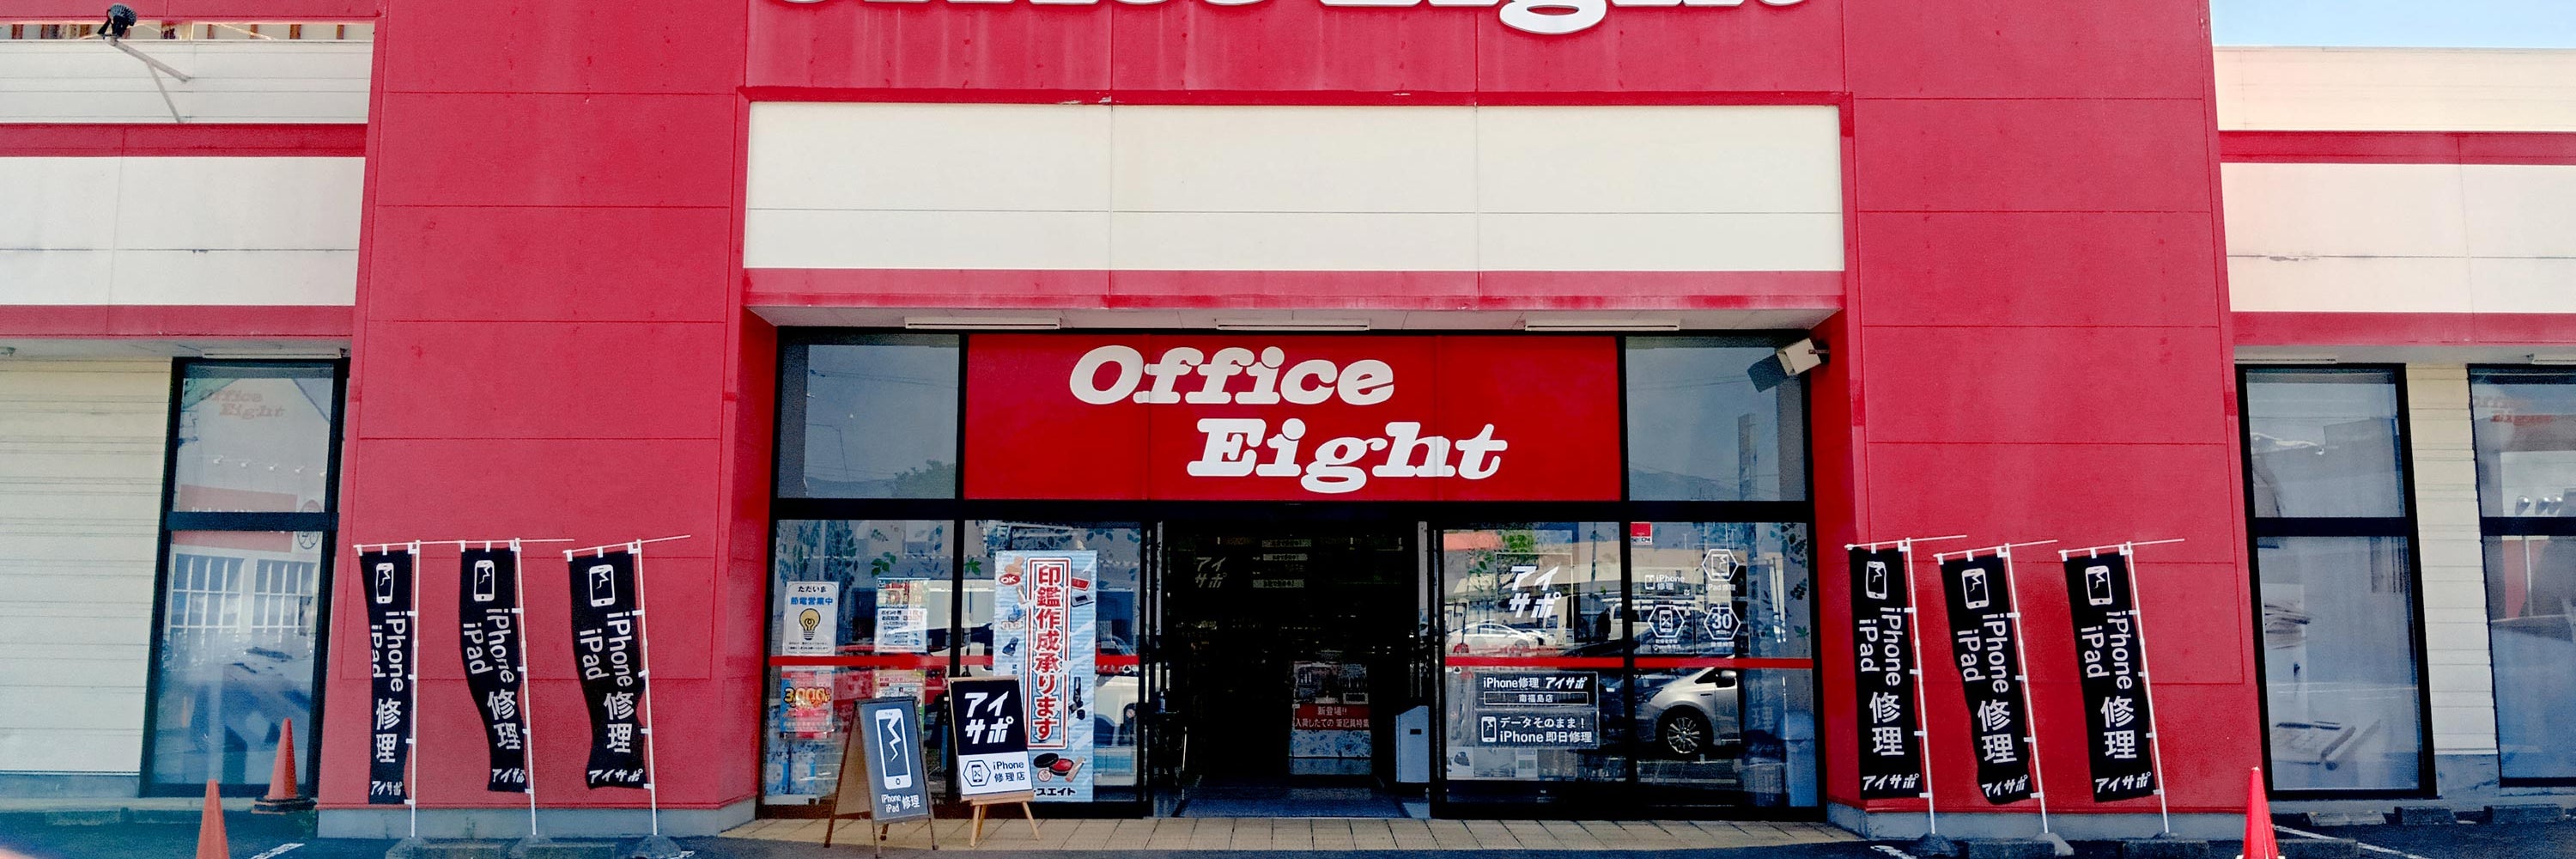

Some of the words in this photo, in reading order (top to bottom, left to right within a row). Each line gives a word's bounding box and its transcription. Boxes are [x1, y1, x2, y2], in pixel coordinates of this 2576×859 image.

[1069, 345, 1394, 405] Office
[1187, 418, 1508, 494] Eight
[1000, 576, 1017, 584] OK
[1511, 564, 1560, 591] アイ
[1509, 592, 1562, 618] サポ
[1712, 612, 1732, 629] 30
[386, 611, 406, 692] iPhone
[464, 622, 493, 674] iPad
[486, 608, 514, 683] iPhone
[580, 628, 610, 680] iPad
[607, 612, 634, 686] iPhone
[1036, 564, 1062, 740] 印鑑作成承ります
[1859, 619, 1880, 672] iPad
[1880, 607, 1903, 686] iPhone
[1957, 629, 1986, 682] iPad
[1983, 613, 2009, 693] iPhone
[2081, 625, 2110, 678] iPad
[2106, 611, 2132, 689] iPhone
[964, 691, 1009, 717] アイ
[1519, 694, 1553, 703] 南福島店
[1546, 676, 1588, 689] アイサポ
[376, 698, 401, 763] 修理
[487, 688, 521, 750] 修理
[603, 691, 635, 753] 修理
[965, 716, 1014, 744] サポ
[1869, 691, 1905, 756] 修理
[1978, 699, 2017, 764] 修理
[2100, 695, 2137, 758] 修理
[588, 768, 643, 783] アイサポ
[993, 761, 1024, 770] iPhone
[994, 772, 1025, 783] 修理店
[1862, 773, 1919, 790] アイサポ
[1982, 774, 2028, 797] アイサポ
[2095, 771, 2152, 793] アイサポ
[881, 794, 902, 804] iPhone
[885, 804, 900, 813] iPad
[1033, 788, 1076, 796] スエイト
